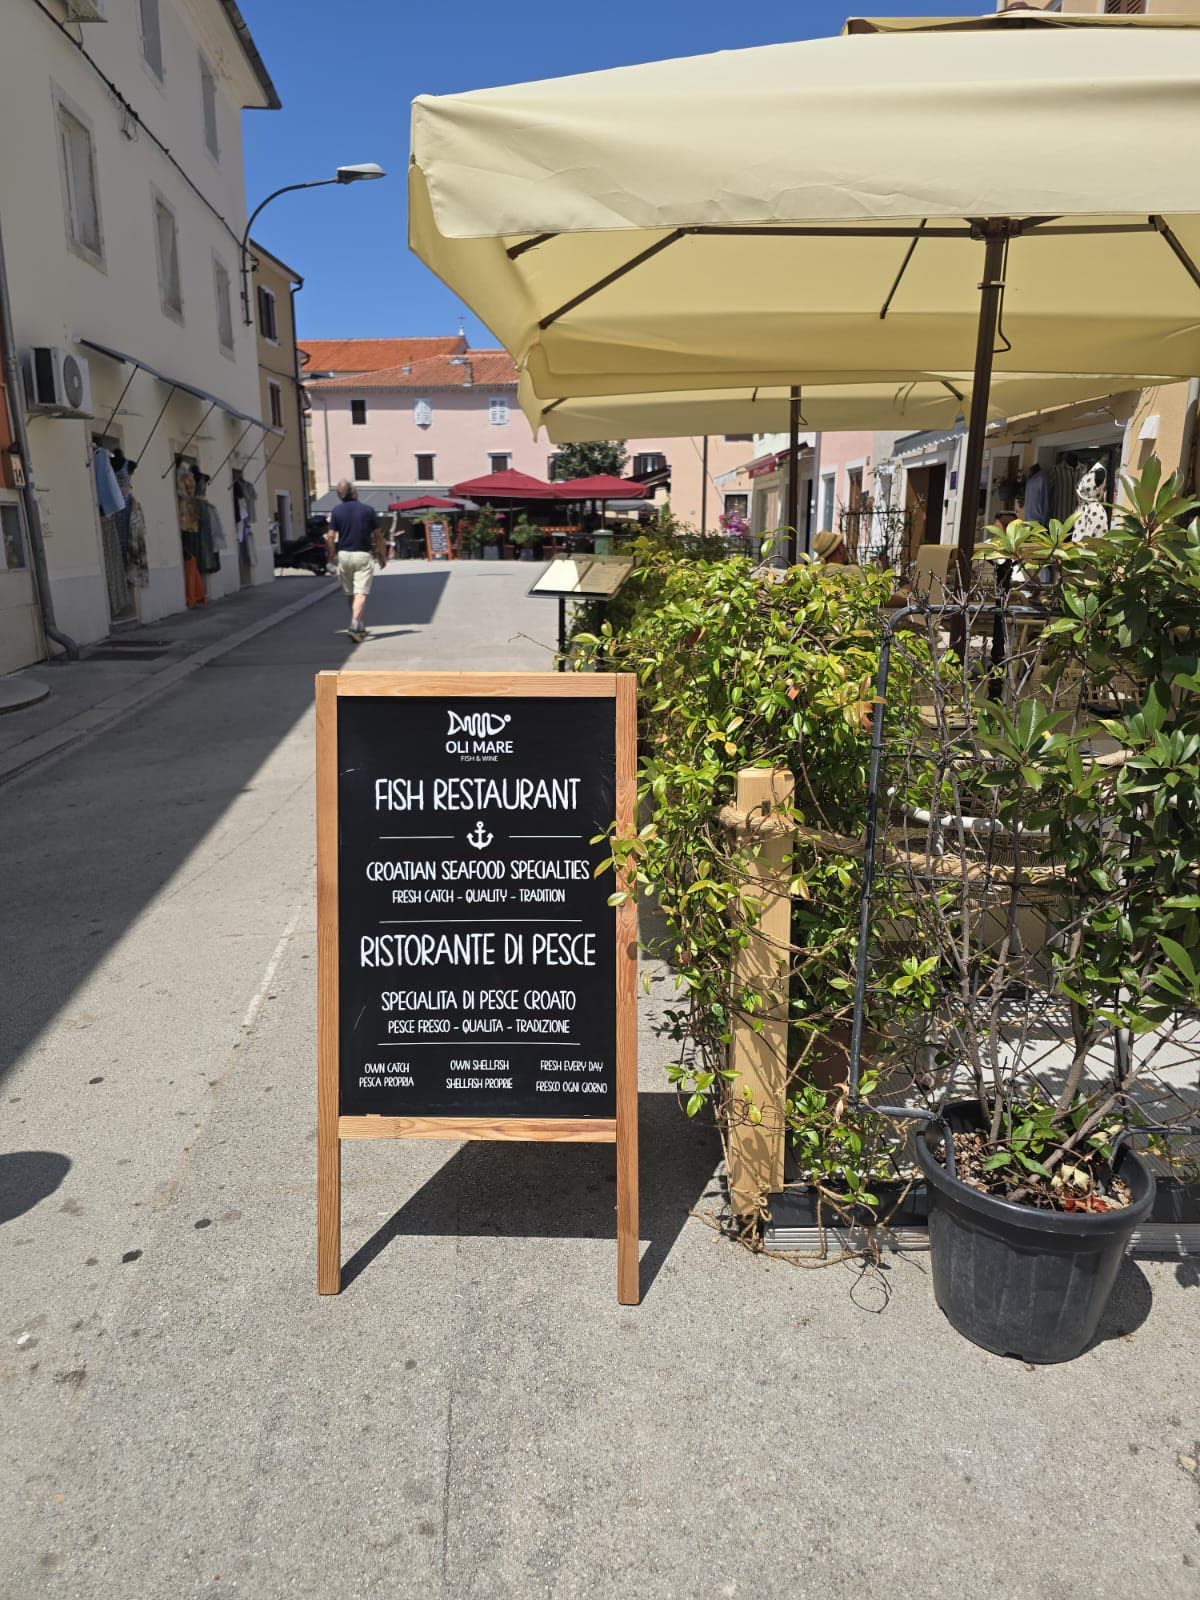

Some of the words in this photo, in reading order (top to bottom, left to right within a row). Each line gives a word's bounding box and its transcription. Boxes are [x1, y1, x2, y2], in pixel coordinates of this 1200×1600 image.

[446, 741, 468, 753] OLI
[473, 741, 513, 753] MARE
[375, 778, 424, 810] FISH
[434, 778, 581, 810] RESTAURANT
[366, 861, 436, 881] CROATIAN
[441, 860, 505, 880] SEAFOOD
[511, 860, 589, 879] SPECIALTIES
[392, 890, 421, 903] FRESH
[424, 889, 454, 903] CATCH
[466, 889, 507, 903] QUALITY
[519, 889, 565, 902] TRADITION
[361, 933, 495, 967] RISTORANTE
[505, 933, 523, 965] DI
[533, 933, 596, 966] PESCE
[381, 990, 457, 1011] SPECIALITA
[463, 990, 474, 1009] DI
[480, 990, 519, 1009] PESCE
[524, 990, 576, 1010] CROATO
[388, 1020, 415, 1033] PESCE
[418, 1019, 450, 1033] FRESCO
[462, 1019, 503, 1034] QUALITA
[516, 1019, 570, 1033] TRADIZIONE
[365, 1063, 385, 1073] OWN
[387, 1062, 409, 1073] CATCH
[450, 1060, 470, 1070] OWN
[473, 1060, 509, 1070] SHELLFISH
[541, 1060, 562, 1071] FRESH
[564, 1060, 586, 1071] EVERY
[589, 1061, 603, 1072] DAY
[359, 1077, 382, 1087] PESCA
[384, 1076, 414, 1087] PROPRIA
[446, 1078, 483, 1088] SHELLFISH
[485, 1078, 512, 1088] PROPRIE
[536, 1081, 560, 1091] FRESCO
[563, 1081, 579, 1092] OGNI
[581, 1082, 607, 1093] GIORNO
